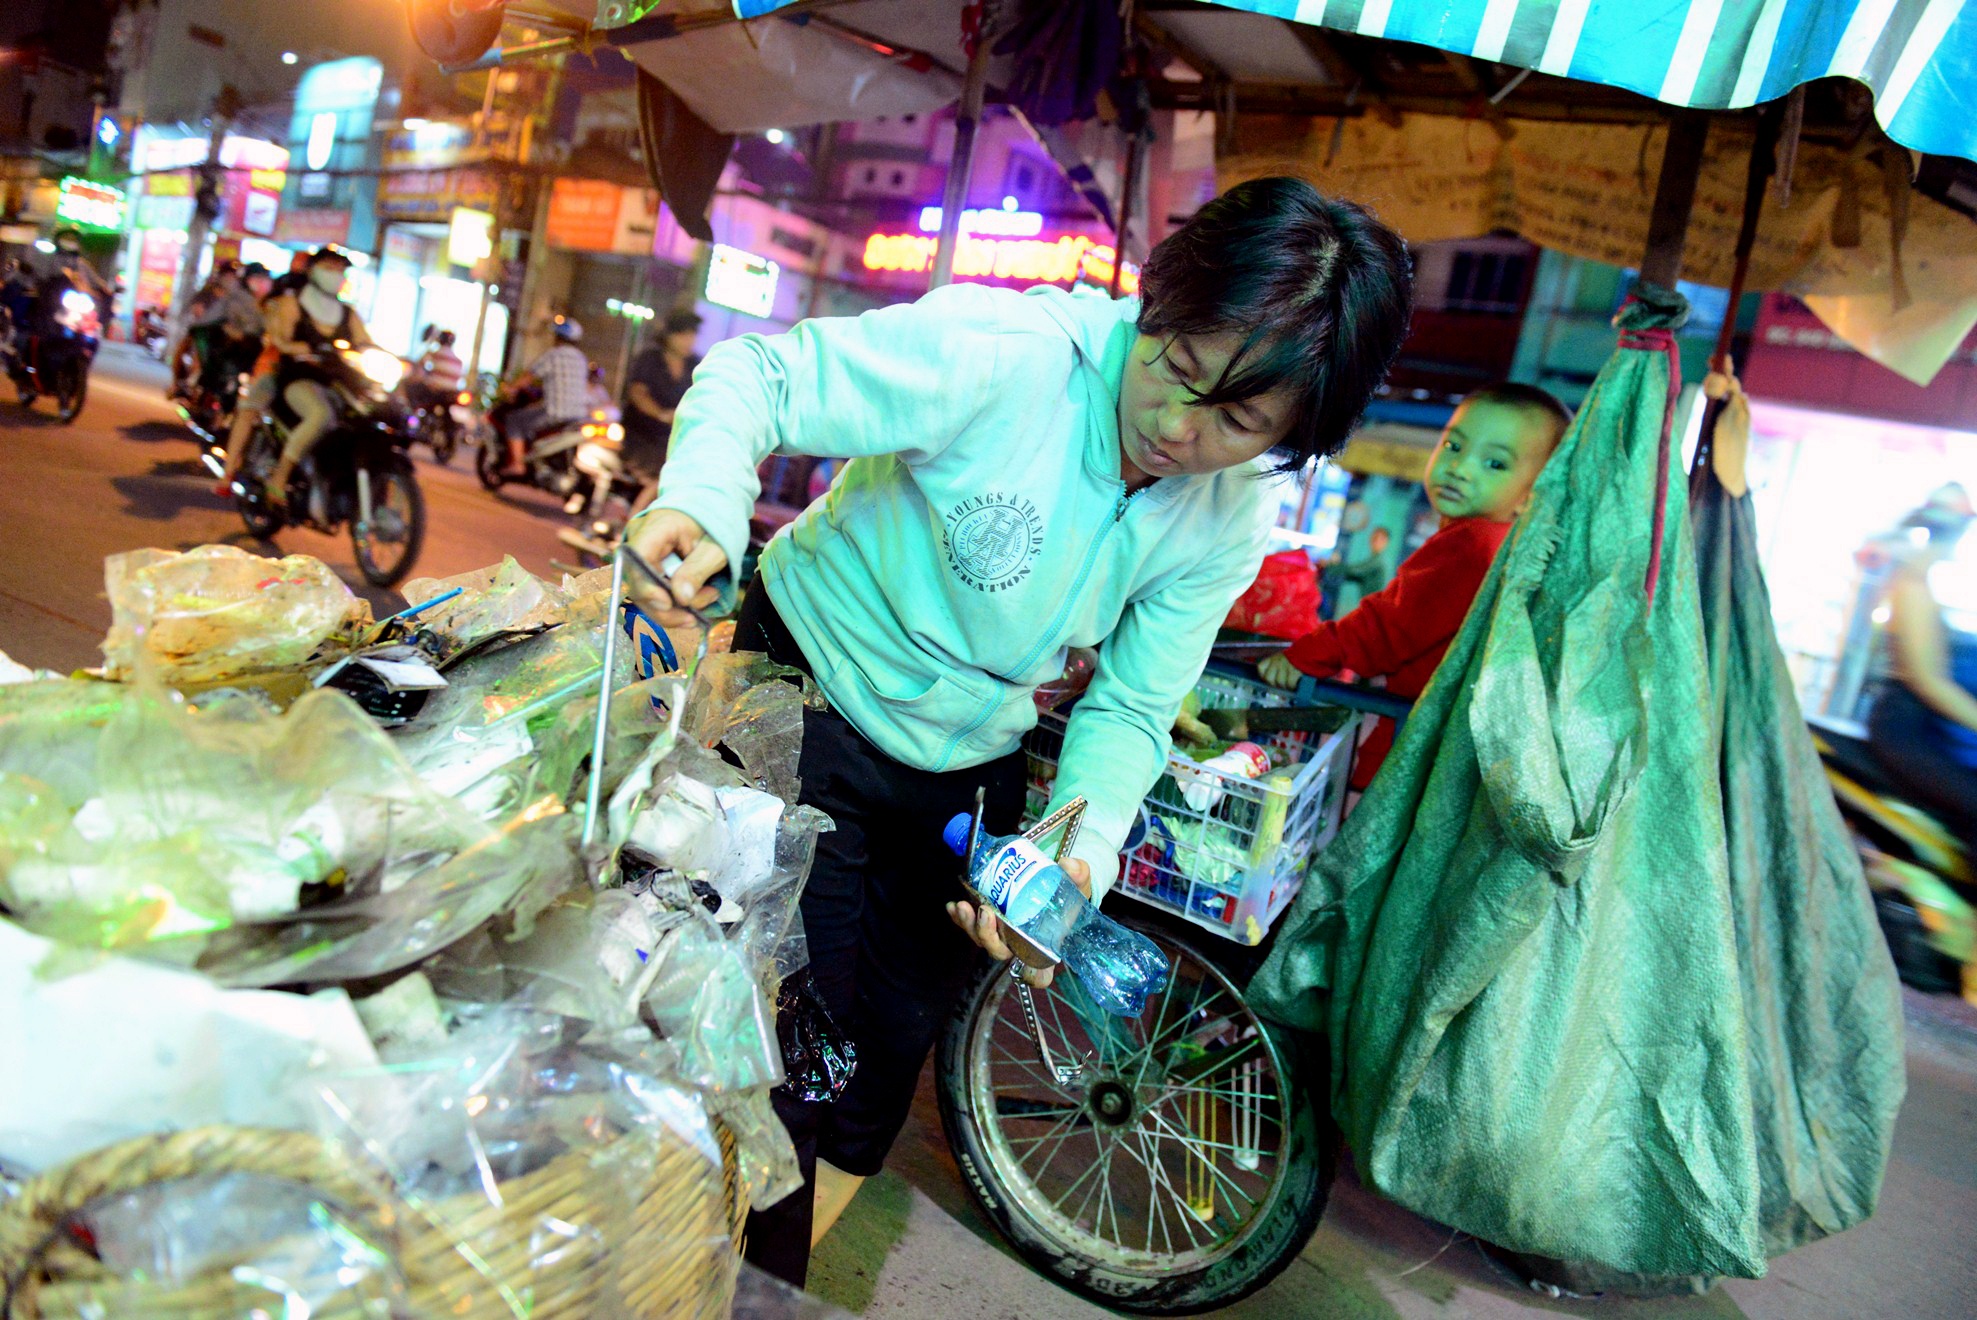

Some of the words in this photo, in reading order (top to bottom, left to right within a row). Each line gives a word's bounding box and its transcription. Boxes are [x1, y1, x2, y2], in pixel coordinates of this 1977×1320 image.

[946, 491, 1004, 522] YOUNGS
[1009, 493, 1018, 506] &
[1020, 498, 1044, 556] TRENDS
[942, 529, 1031, 593] GENERATION
[988, 853, 1027, 908] AQUARIUS
[960, 1153, 998, 1209] MAXXIS
